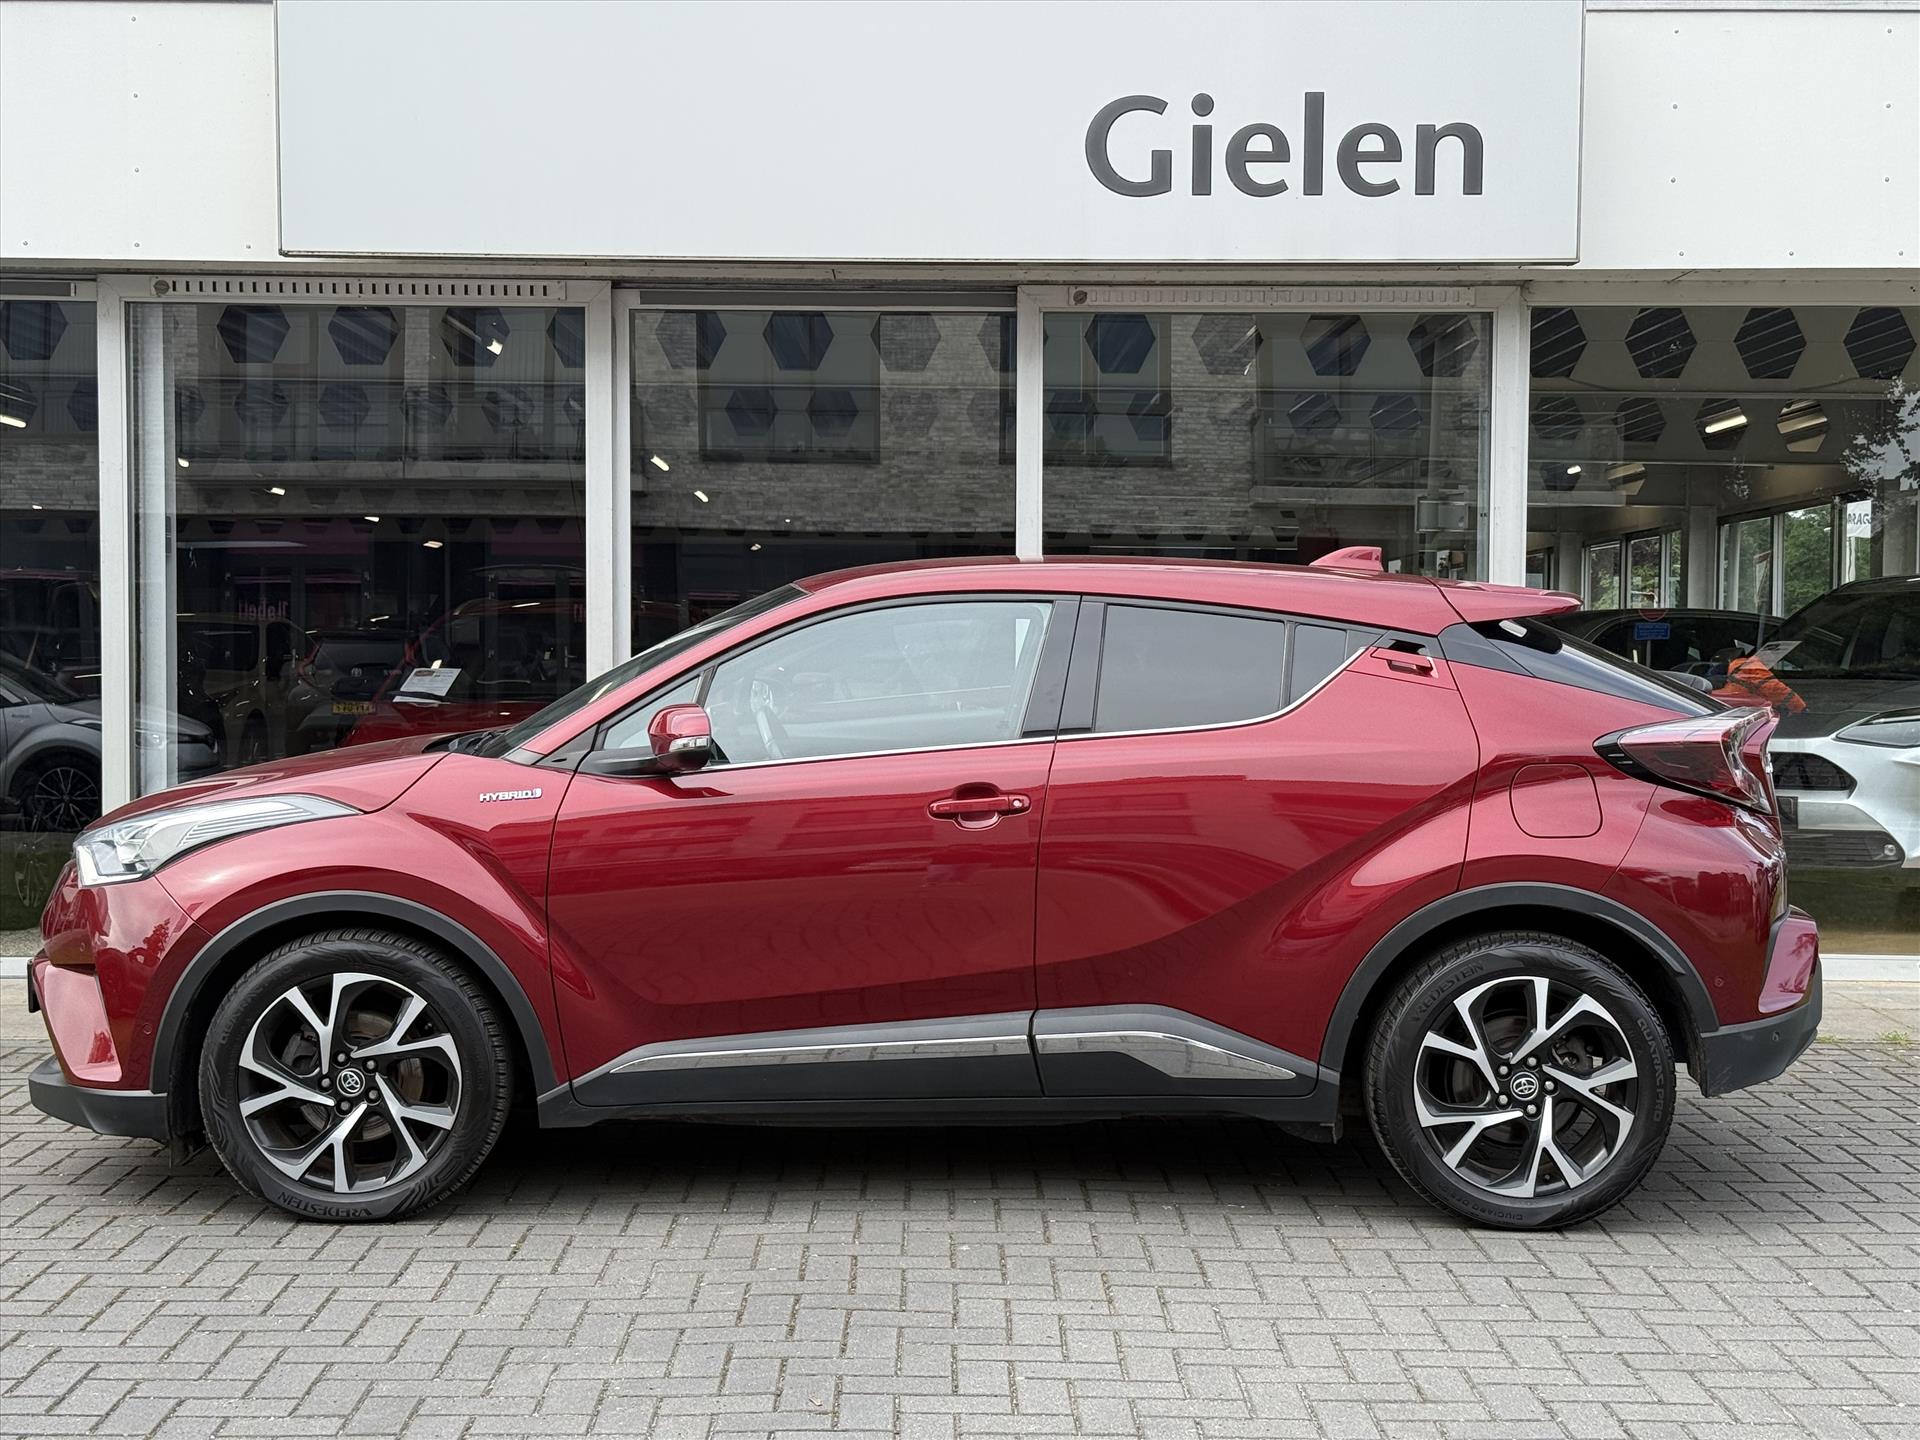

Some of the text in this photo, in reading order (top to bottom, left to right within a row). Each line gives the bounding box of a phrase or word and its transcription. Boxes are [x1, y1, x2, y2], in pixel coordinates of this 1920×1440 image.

[1085, 92, 1483, 198] Gielen
[479, 790, 532, 802] HYBRID
[1409, 963, 1485, 1024] VREDESTEIN
[1636, 1016, 1665, 1122] QUATRAC PRO
[277, 1190, 373, 1219] VREDESTEIN
